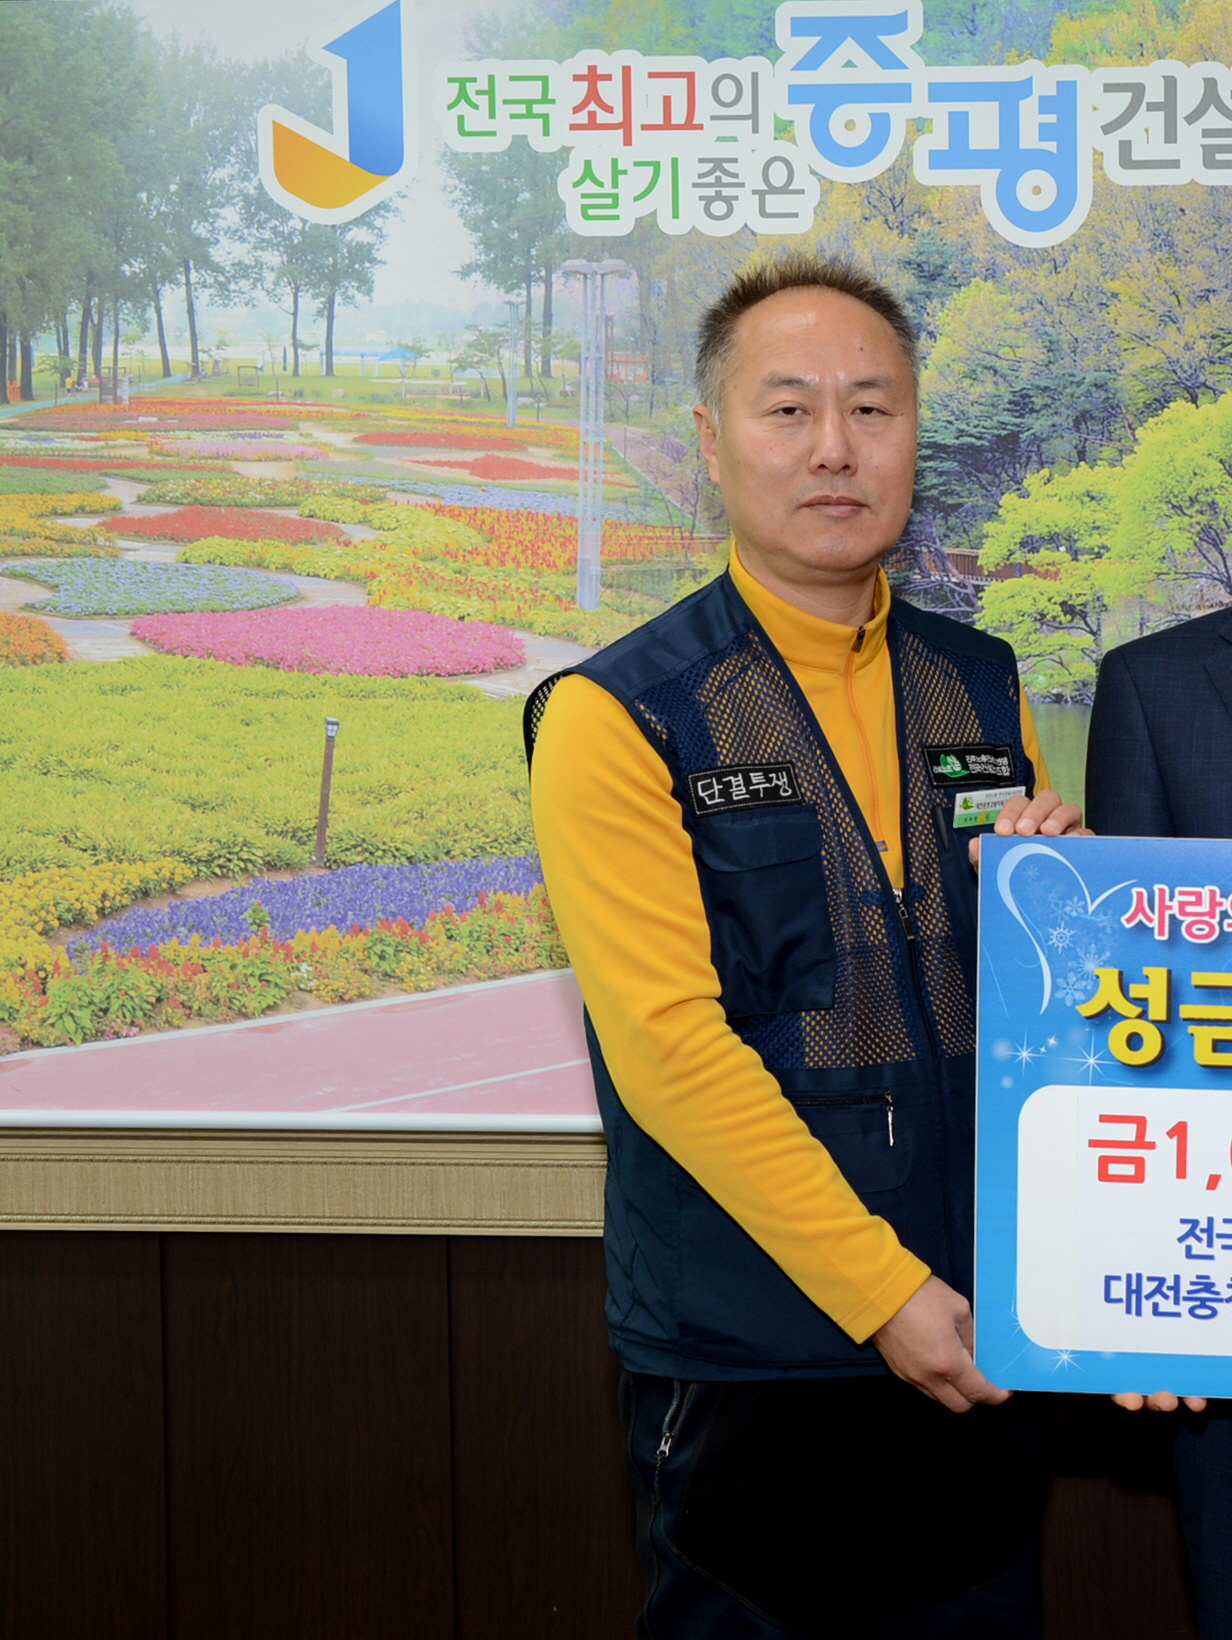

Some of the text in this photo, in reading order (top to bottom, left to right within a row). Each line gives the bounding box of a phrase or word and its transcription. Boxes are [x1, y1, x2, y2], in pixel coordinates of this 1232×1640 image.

[445, 64, 761, 147] 전국 최고의
[787, 14, 1077, 233] 증평
[697, 770, 793, 805] 단결투쟁
